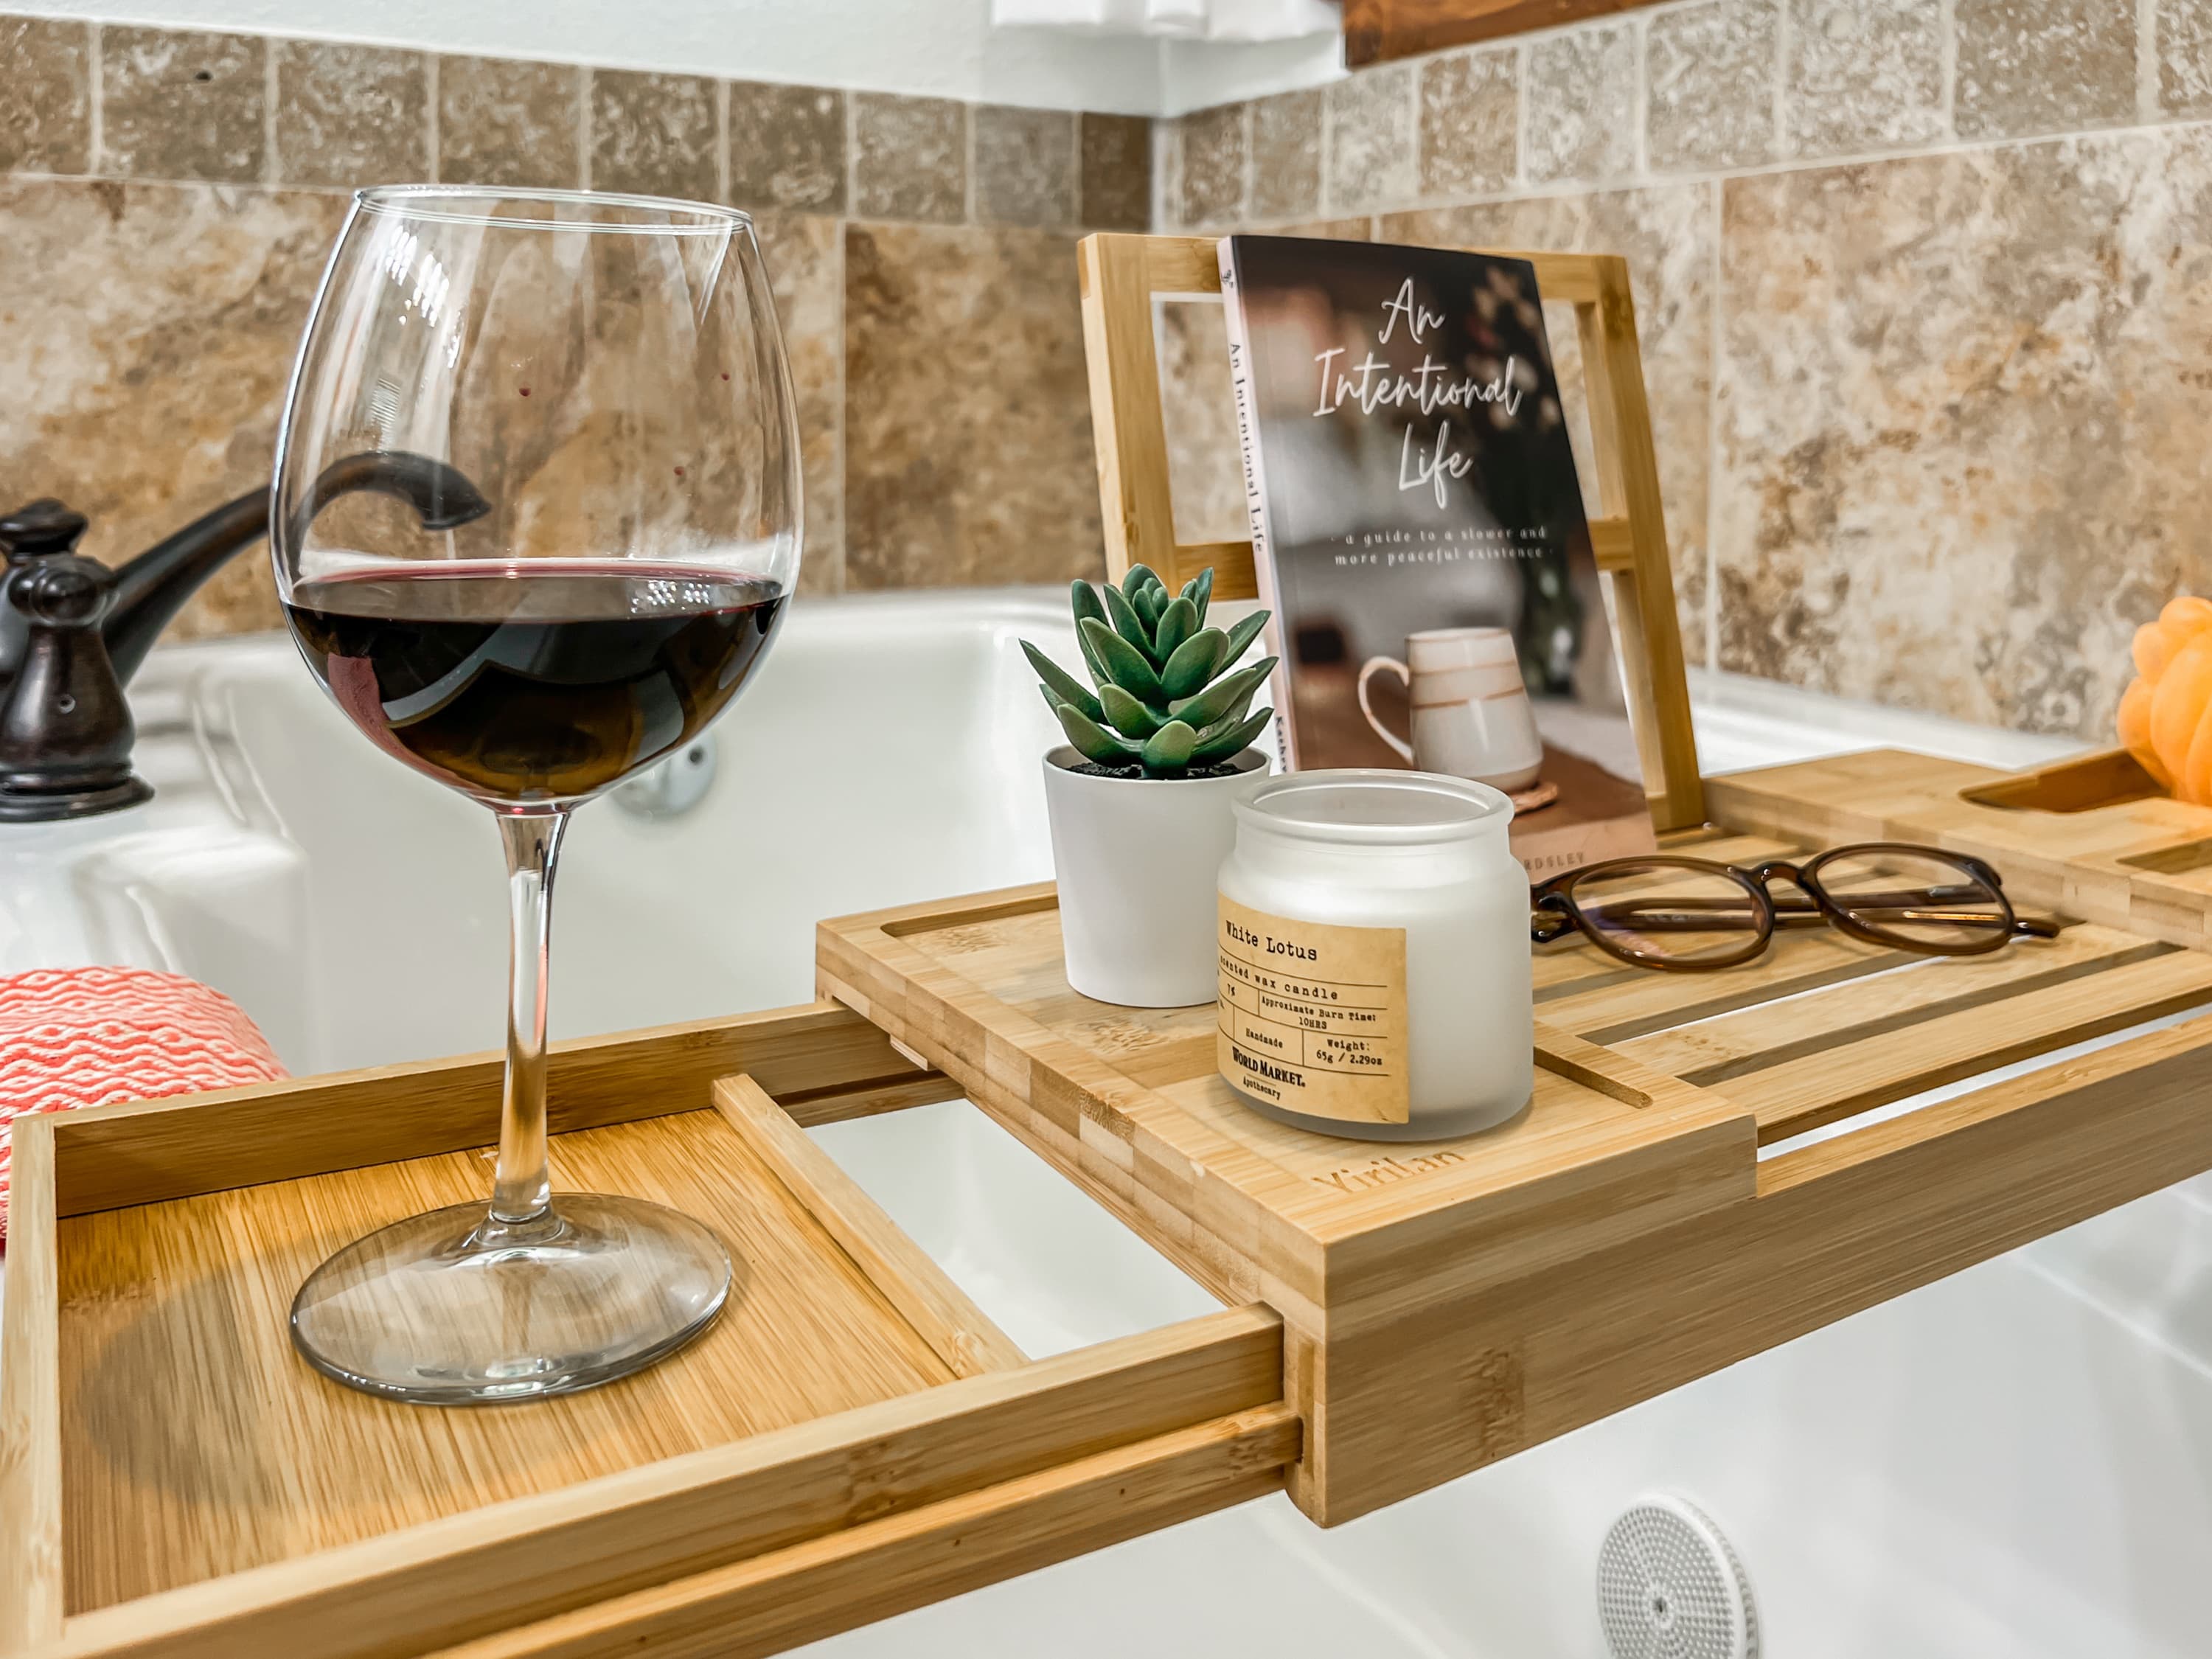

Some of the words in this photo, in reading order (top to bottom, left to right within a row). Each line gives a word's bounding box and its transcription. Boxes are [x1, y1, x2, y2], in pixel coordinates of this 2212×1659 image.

[1378, 278, 1445, 344] An
[1231, 343, 1241, 369] An
[1312, 348, 1523, 417] Intentional
[1235, 378, 1259, 497] Intentional
[1399, 419, 1472, 509] Life
[1251, 507, 1265, 553] Life
[1346, 535, 1354, 544] a
[1364, 530, 1411, 547] guide
[1420, 530, 1436, 541] to
[1444, 531, 1453, 540] a
[1461, 527, 1512, 540] slower
[1520, 525, 1546, 539] and
[1335, 554, 1377, 566] more
[1388, 548, 1459, 566] peaceful
[1468, 548, 1543, 559] existence
[1226, 919, 1259, 947] White
[1265, 936, 1317, 961] Lotus
[1255, 974, 1276, 989] wax
[1284, 984, 1338, 1000] candle
[1262, 995, 1314, 1015] Approximate
[1318, 1009, 1343, 1019] Burn
[1349, 1012, 1376, 1021] Time:
[1245, 1027, 1284, 1048] Handmade
[1327, 1039, 1370, 1051] Weight:
[1232, 1046, 1259, 1072] WORLD
[1316, 1049, 1333, 1064] 65g
[1349, 1054, 1382, 1065] 2.29oz
[1243, 1076, 1281, 1101] Apothecary
